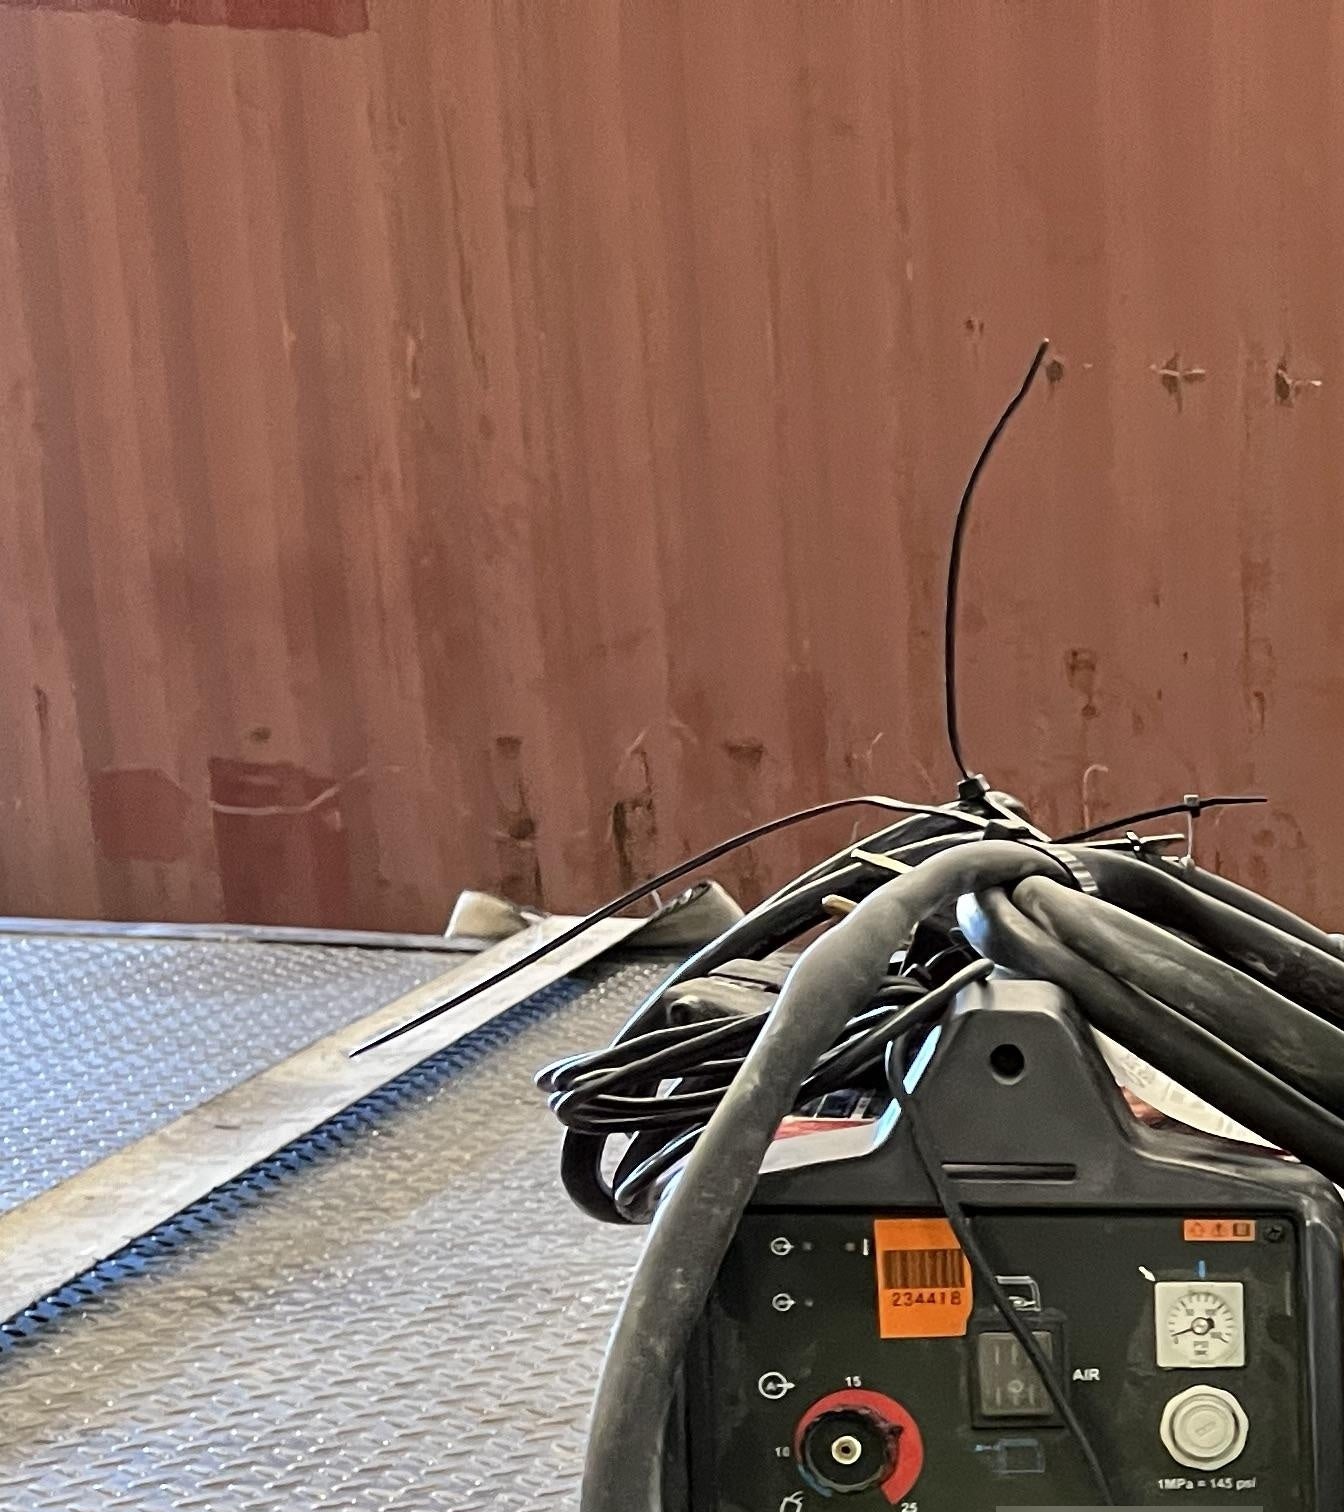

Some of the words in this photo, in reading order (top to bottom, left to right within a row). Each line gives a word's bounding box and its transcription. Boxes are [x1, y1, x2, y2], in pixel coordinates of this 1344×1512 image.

[892, 1290, 962, 1307] 234418
[1072, 1368, 1101, 1381] AIR
[845, 1376, 861, 1387] 15
